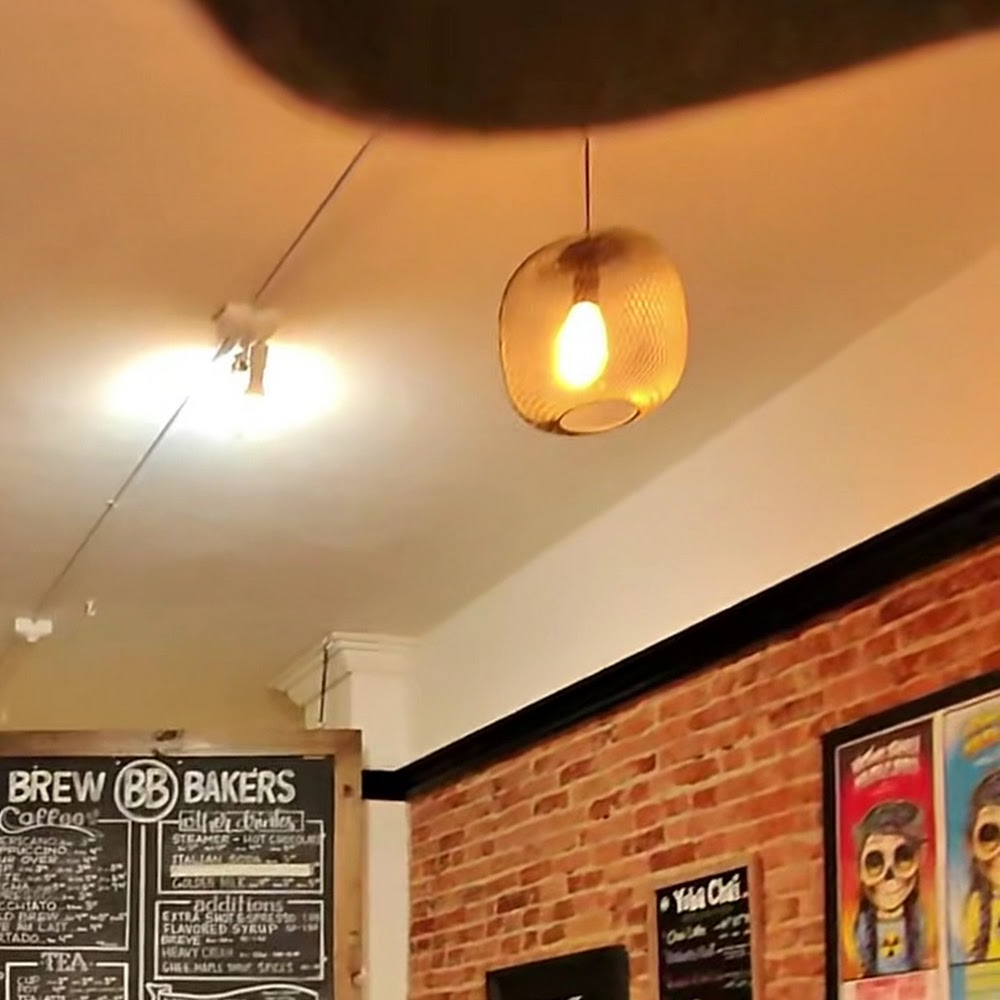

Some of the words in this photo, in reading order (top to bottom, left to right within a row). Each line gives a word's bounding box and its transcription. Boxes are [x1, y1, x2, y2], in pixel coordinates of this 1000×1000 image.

[8, 770, 106, 803] BREW
[123, 768, 170, 809] BB
[183, 769, 297, 804] BAKERS
[172, 834, 230, 845] STEAMER
[193, 895, 284, 912] additions
[162, 911, 200, 922] EXTRA
[163, 923, 228, 934] FLAVORED
[232, 923, 278, 934] SYRUP
[40, 952, 89, 972] TEA
[17, 975, 41, 985] CUP
